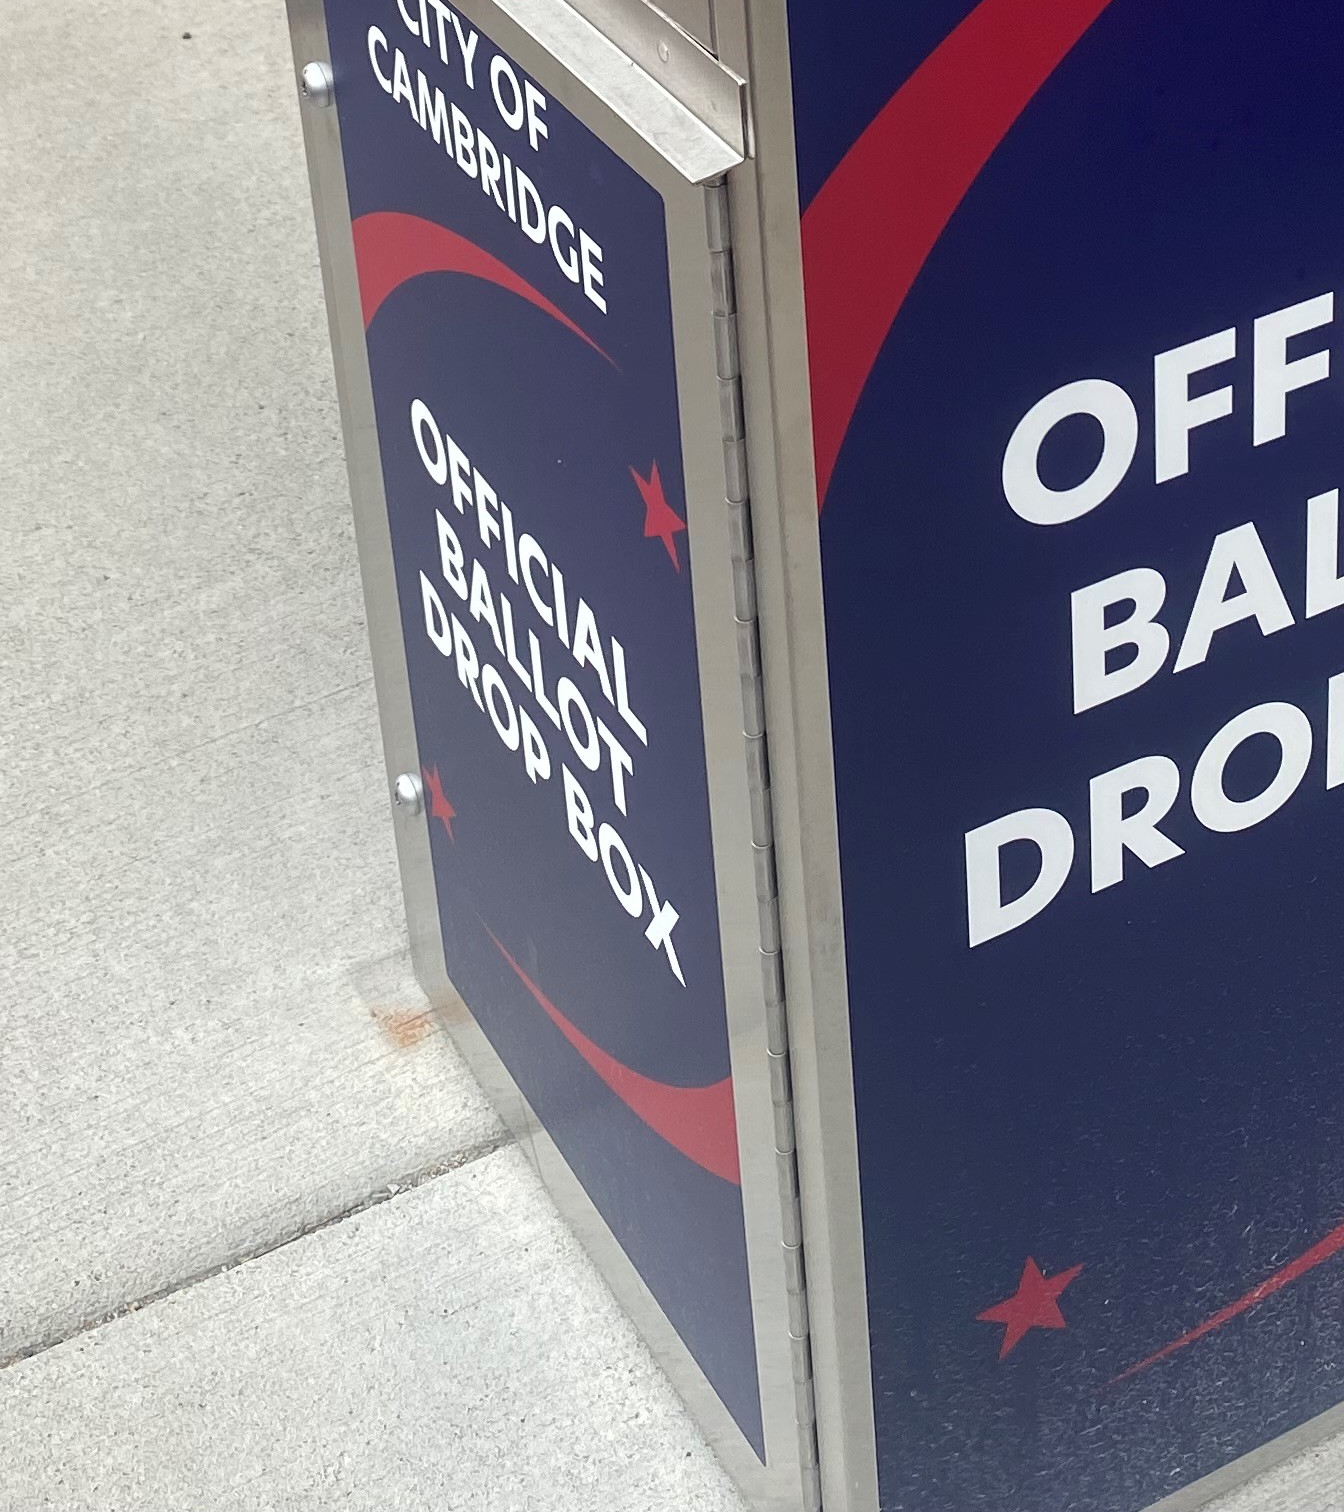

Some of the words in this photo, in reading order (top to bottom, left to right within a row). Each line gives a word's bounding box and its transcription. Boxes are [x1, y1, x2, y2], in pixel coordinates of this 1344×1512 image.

[367, 25, 607, 315] CAMBRIDGE
[489, 54, 548, 152] OF
[411, 398, 648, 747] OFFICIAL
[435, 509, 633, 817] BALLOT
[419, 569, 551, 784] DROP
[561, 762, 686, 989] BOX
